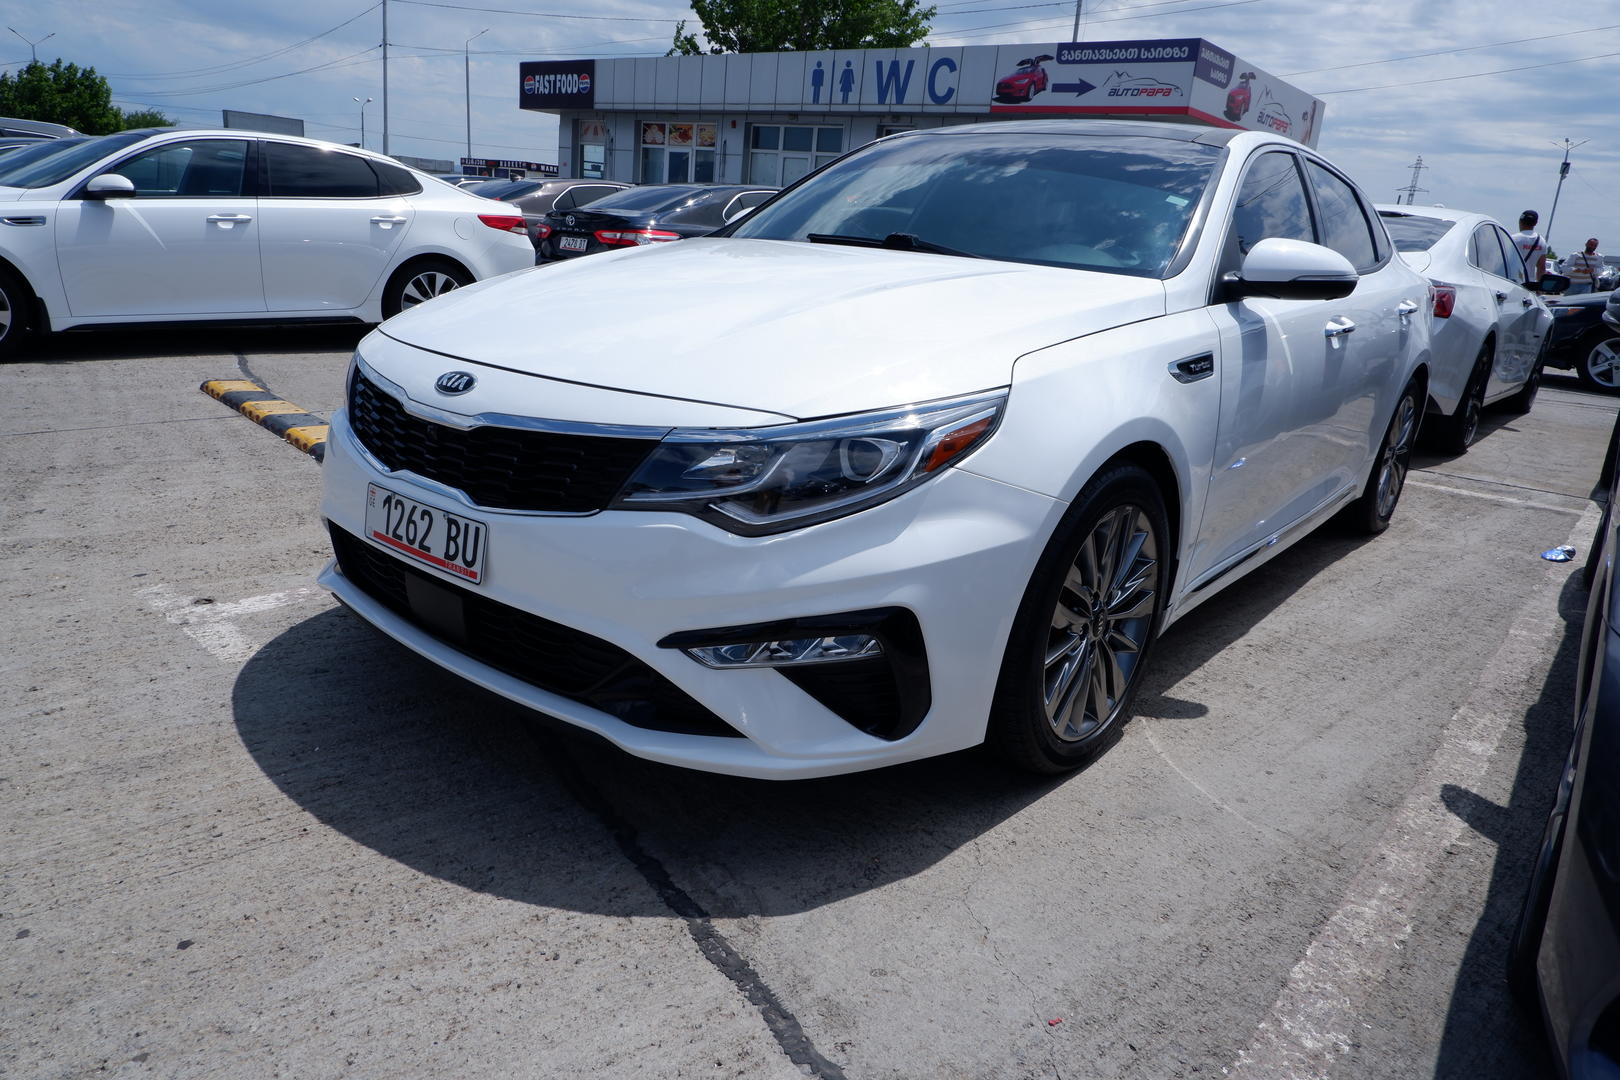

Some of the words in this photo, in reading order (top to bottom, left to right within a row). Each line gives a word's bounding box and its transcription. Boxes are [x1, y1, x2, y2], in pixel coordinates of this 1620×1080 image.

[1141, 46, 1189, 59] საიტზე
[534, 74, 556, 94] FAST
[556, 73, 578, 94] FOOD
[438, 373, 470, 391] KIA
[382, 494, 433, 553] 1262
[443, 516, 481, 568] BU
